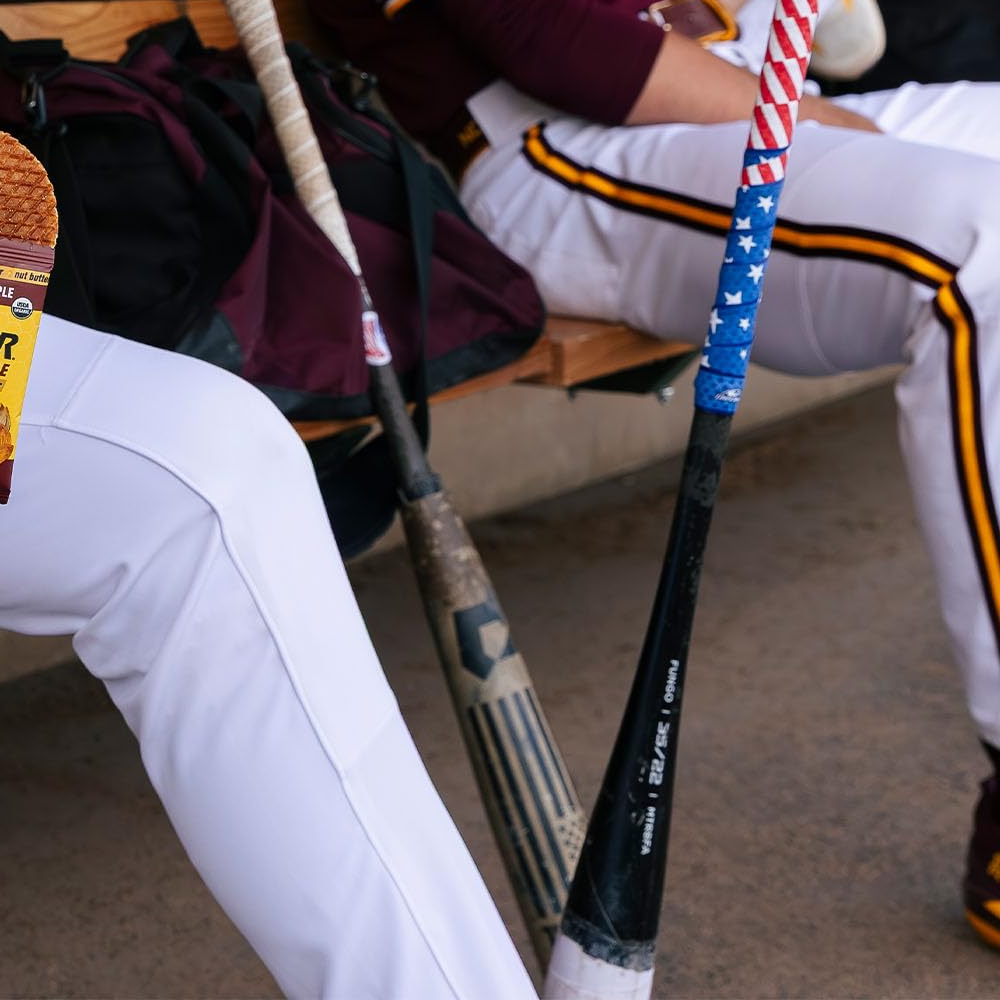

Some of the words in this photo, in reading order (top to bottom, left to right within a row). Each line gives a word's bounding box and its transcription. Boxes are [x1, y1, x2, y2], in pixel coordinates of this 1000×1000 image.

[14, 271, 28, 280] nut
[663, 659, 680, 703] FUNGO
[648, 720, 670, 786] 35/22
